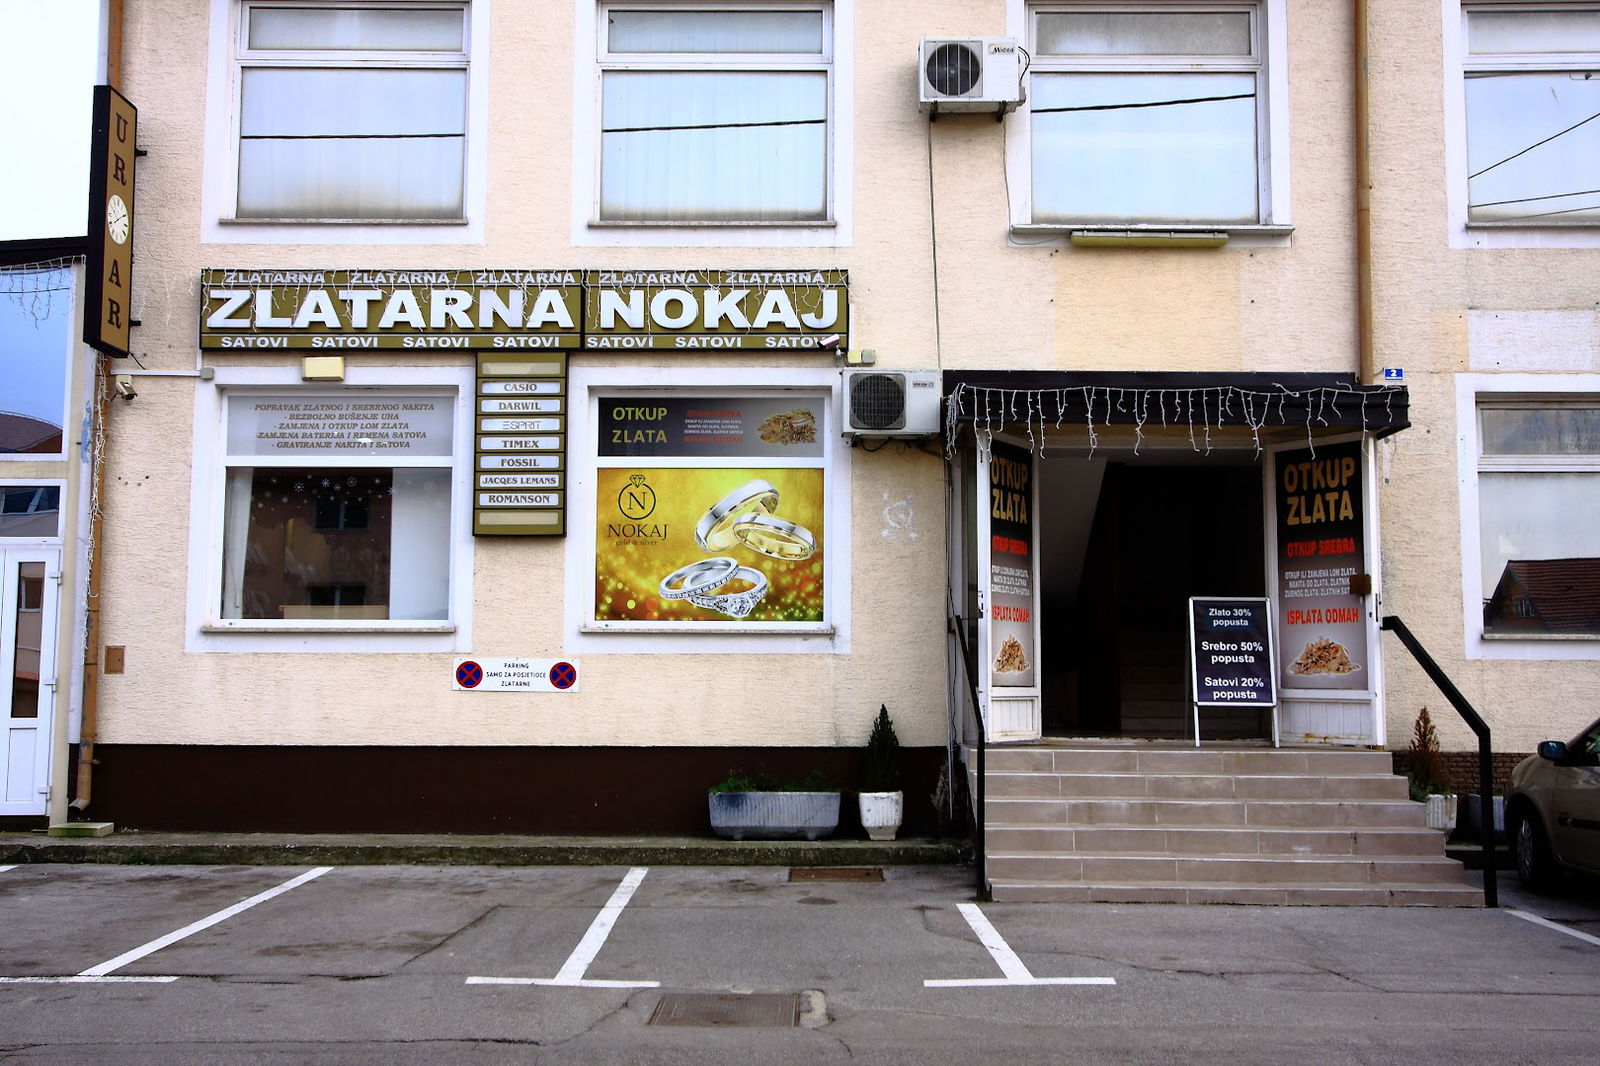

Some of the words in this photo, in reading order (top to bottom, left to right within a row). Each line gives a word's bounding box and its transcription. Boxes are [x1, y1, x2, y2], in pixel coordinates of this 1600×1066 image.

[225, 272, 326, 284] ZLATARNA
[350, 272, 450, 284] ZLATARNA
[476, 272, 576, 284] ZLATARNA
[600, 272, 699, 284] ZLATARNA
[726, 272, 825, 284] ZLATARNA
[206, 289, 575, 329] ZLATARNA
[600, 289, 839, 330] NOKAJ
[221, 337, 288, 348] SATOVI
[311, 337, 378, 348] SATOVI
[403, 337, 469, 348] SATOVI
[493, 337, 560, 348] SATOVI
[587, 337, 653, 348] SATOVI
[675, 337, 742, 348] SATOVI
[1390, 369, 1397, 377] 2
[504, 383, 537, 392] CASIO
[498, 402, 541, 411] DARWIL
[338, 412, 379, 420] BUŠENJE
[612, 407, 668, 421] OTKUP
[502, 420, 542, 430] ESPRIT
[612, 430, 668, 443] ZLATA
[502, 440, 539, 448] TIMEX
[500, 458, 540, 467] FOSSIL
[991, 454, 1028, 491] OTKUP
[1283, 457, 1356, 493] OTKUP
[482, 477, 518, 485] JACQES
[520, 477, 556, 485] LEMANS
[488, 494, 551, 504] ROMANSON
[627, 491, 647, 510] N
[992, 488, 1027, 525] ZLATA
[1286, 489, 1354, 526] ZLATA
[608, 523, 668, 541] NOKAJ
[1287, 541, 1317, 558] OTKUP
[1319, 537, 1356, 556] SREBRA
[1209, 608, 1231, 616] Zlato
[1233, 608, 1252, 616] 30%
[1287, 609, 1323, 625] ISPLATA
[1325, 607, 1360, 624] ODMAH
[1213, 618, 1249, 627] popusta
[1202, 641, 1238, 651] Srebro
[1241, 641, 1263, 652] 50%
[1211, 654, 1255, 664] popusta
[1204, 676, 1239, 687] Satovi
[1241, 677, 1264, 688] 20%
[1213, 690, 1257, 700] popusta
